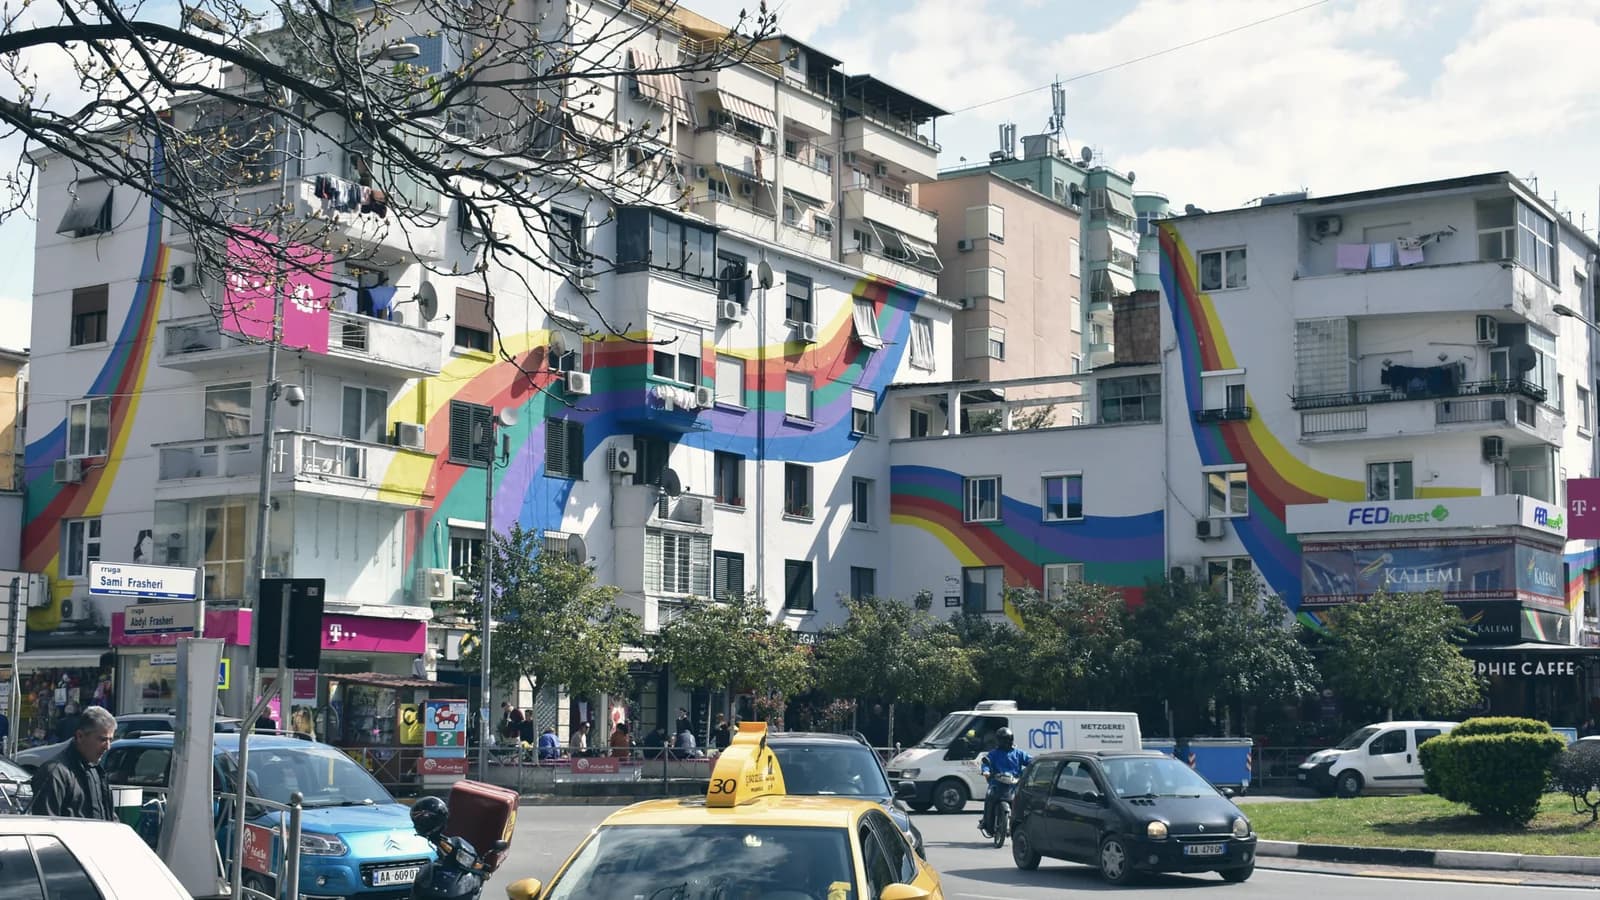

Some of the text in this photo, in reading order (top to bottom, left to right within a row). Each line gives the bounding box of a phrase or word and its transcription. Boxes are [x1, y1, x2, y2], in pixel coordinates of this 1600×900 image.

[1348, 507, 1429, 525] FEDinvest
[101, 576, 163, 589] Sami Frasheri
[1384, 567, 1463, 584] KALEMI
[1534, 568, 1557, 588] KALEMI
[1477, 624, 1514, 632] KALEMI
[1080, 723, 1125, 731] METZGEREI
[709, 778, 737, 794] 30
[380, 871, 390, 881] AA
